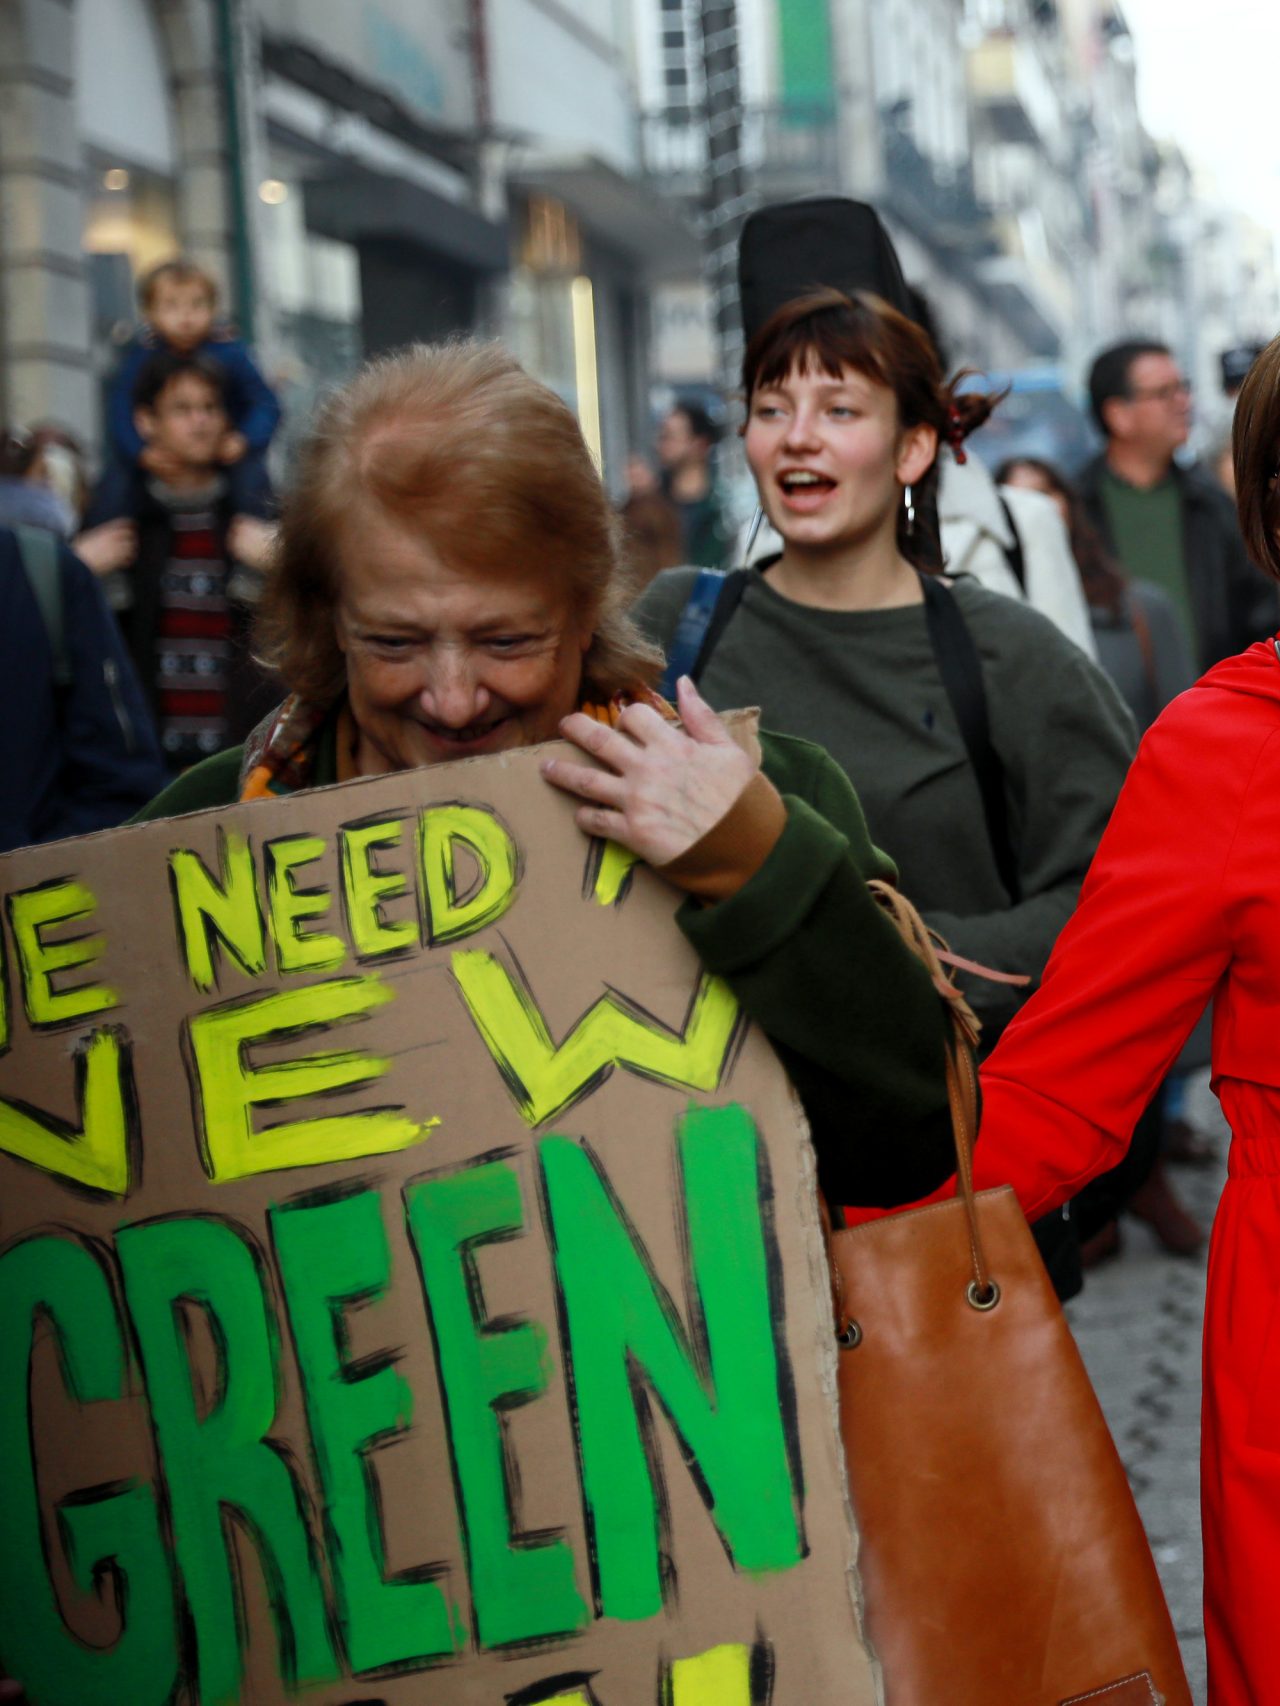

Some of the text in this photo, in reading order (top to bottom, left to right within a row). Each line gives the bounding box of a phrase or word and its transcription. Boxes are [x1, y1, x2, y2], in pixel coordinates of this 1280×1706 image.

[0, 800, 524, 1058] E NEED
[0, 1102, 810, 1706] GREEN
